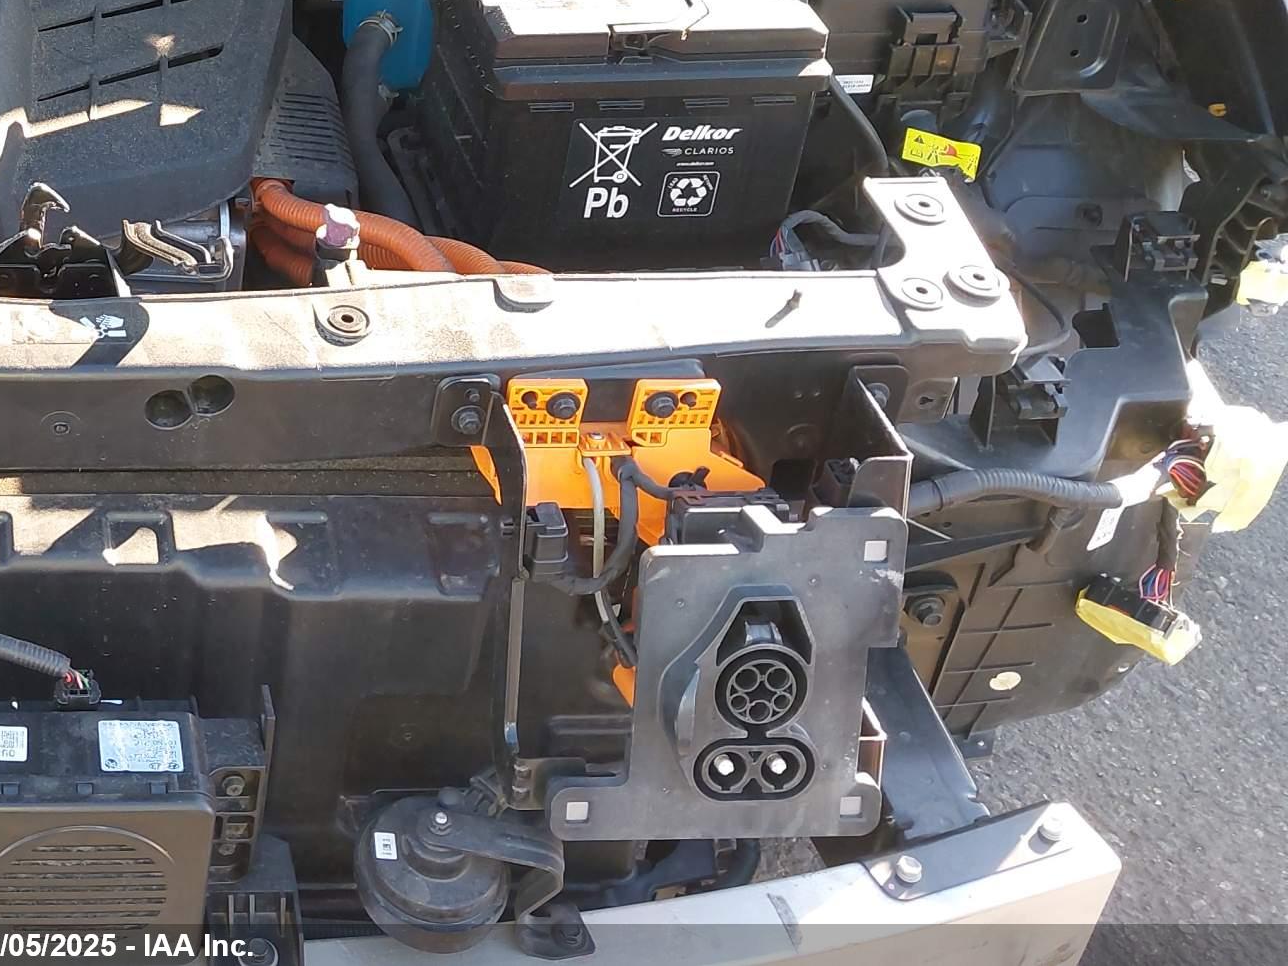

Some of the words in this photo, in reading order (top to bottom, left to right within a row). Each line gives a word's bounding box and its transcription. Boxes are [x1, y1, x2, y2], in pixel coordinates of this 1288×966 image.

[662, 125, 743, 141] Delkor
[684, 146, 735, 156] CLARIOS
[583, 187, 629, 219] Pb
